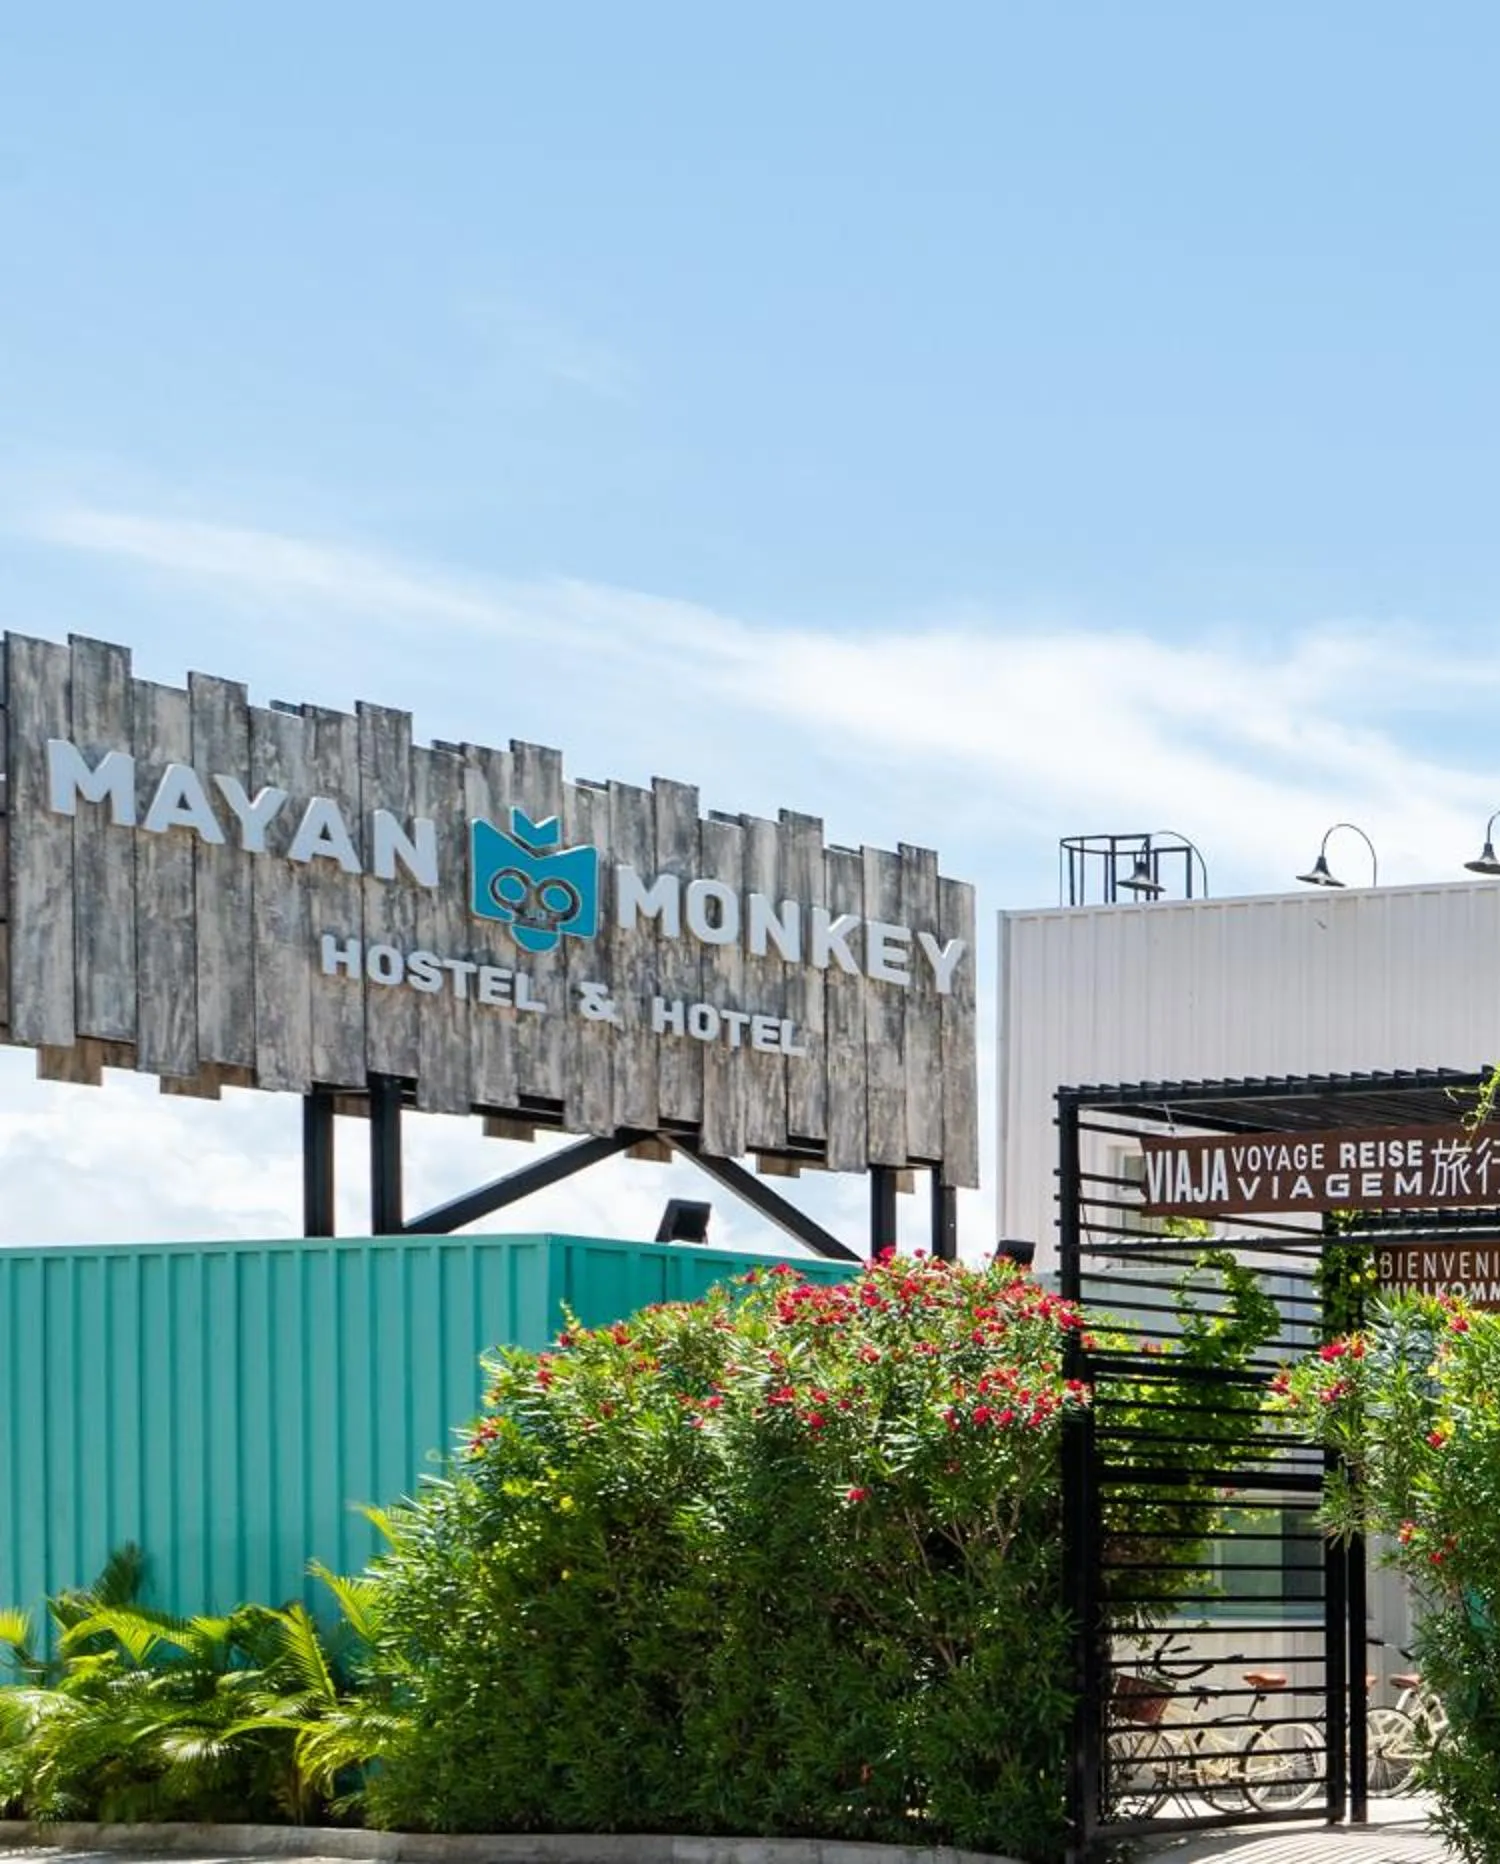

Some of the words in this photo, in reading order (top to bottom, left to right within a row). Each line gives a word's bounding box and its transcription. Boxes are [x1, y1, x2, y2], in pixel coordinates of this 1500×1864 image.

[48, 738, 440, 888] MAYAN
[616, 864, 966, 994] MONKEY
[321, 934, 547, 1013] HOSTEL
[577, 981, 624, 1025] &
[651, 995, 807, 1056] HOTEL
[1146, 1148, 1230, 1204] VIAJA
[1231, 1143, 1325, 1173] VOYAGE
[1339, 1139, 1424, 1169] REISE
[1237, 1171, 1424, 1201] VIAGEM
